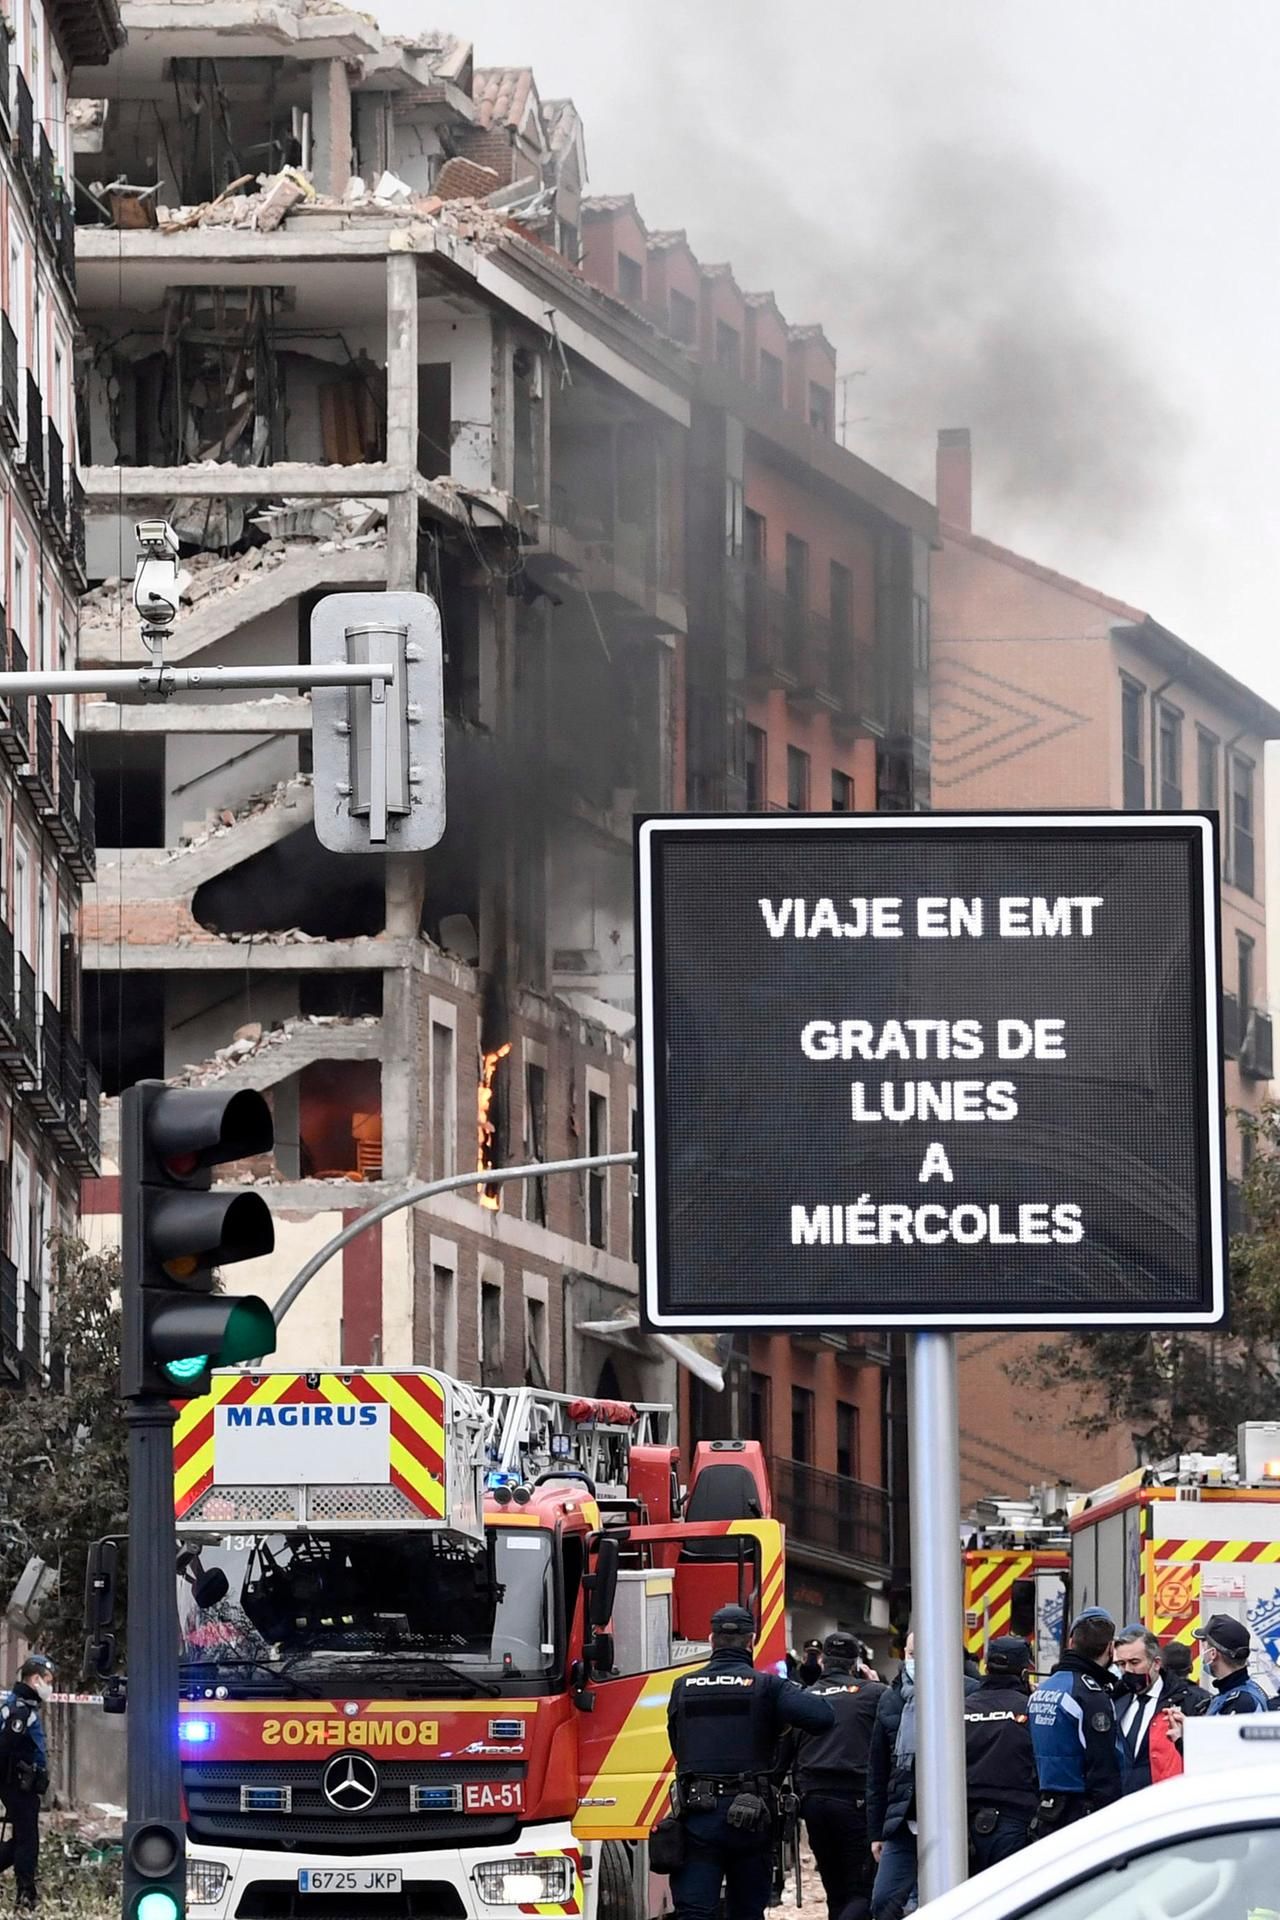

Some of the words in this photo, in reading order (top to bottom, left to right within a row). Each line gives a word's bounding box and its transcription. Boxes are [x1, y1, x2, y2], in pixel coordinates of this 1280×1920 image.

[758, 896, 904, 938] VIAJE
[917, 896, 984, 938] EN
[999, 896, 1104, 938] EMT
[800, 1019, 985, 1061] GRATIS
[997, 1019, 1067, 1061] DE
[851, 1080, 1018, 1122] LUNES
[918, 1143, 954, 1183] A
[790, 1193, 1085, 1246] MIÉRCOLES
[227, 1406, 377, 1427] MAGIRUS
[223, 1534, 269, 1552] 1347
[466, 1783, 522, 1808] EA-51
[312, 1872, 357, 1889] 6725
[364, 1872, 397, 1889] JKP
